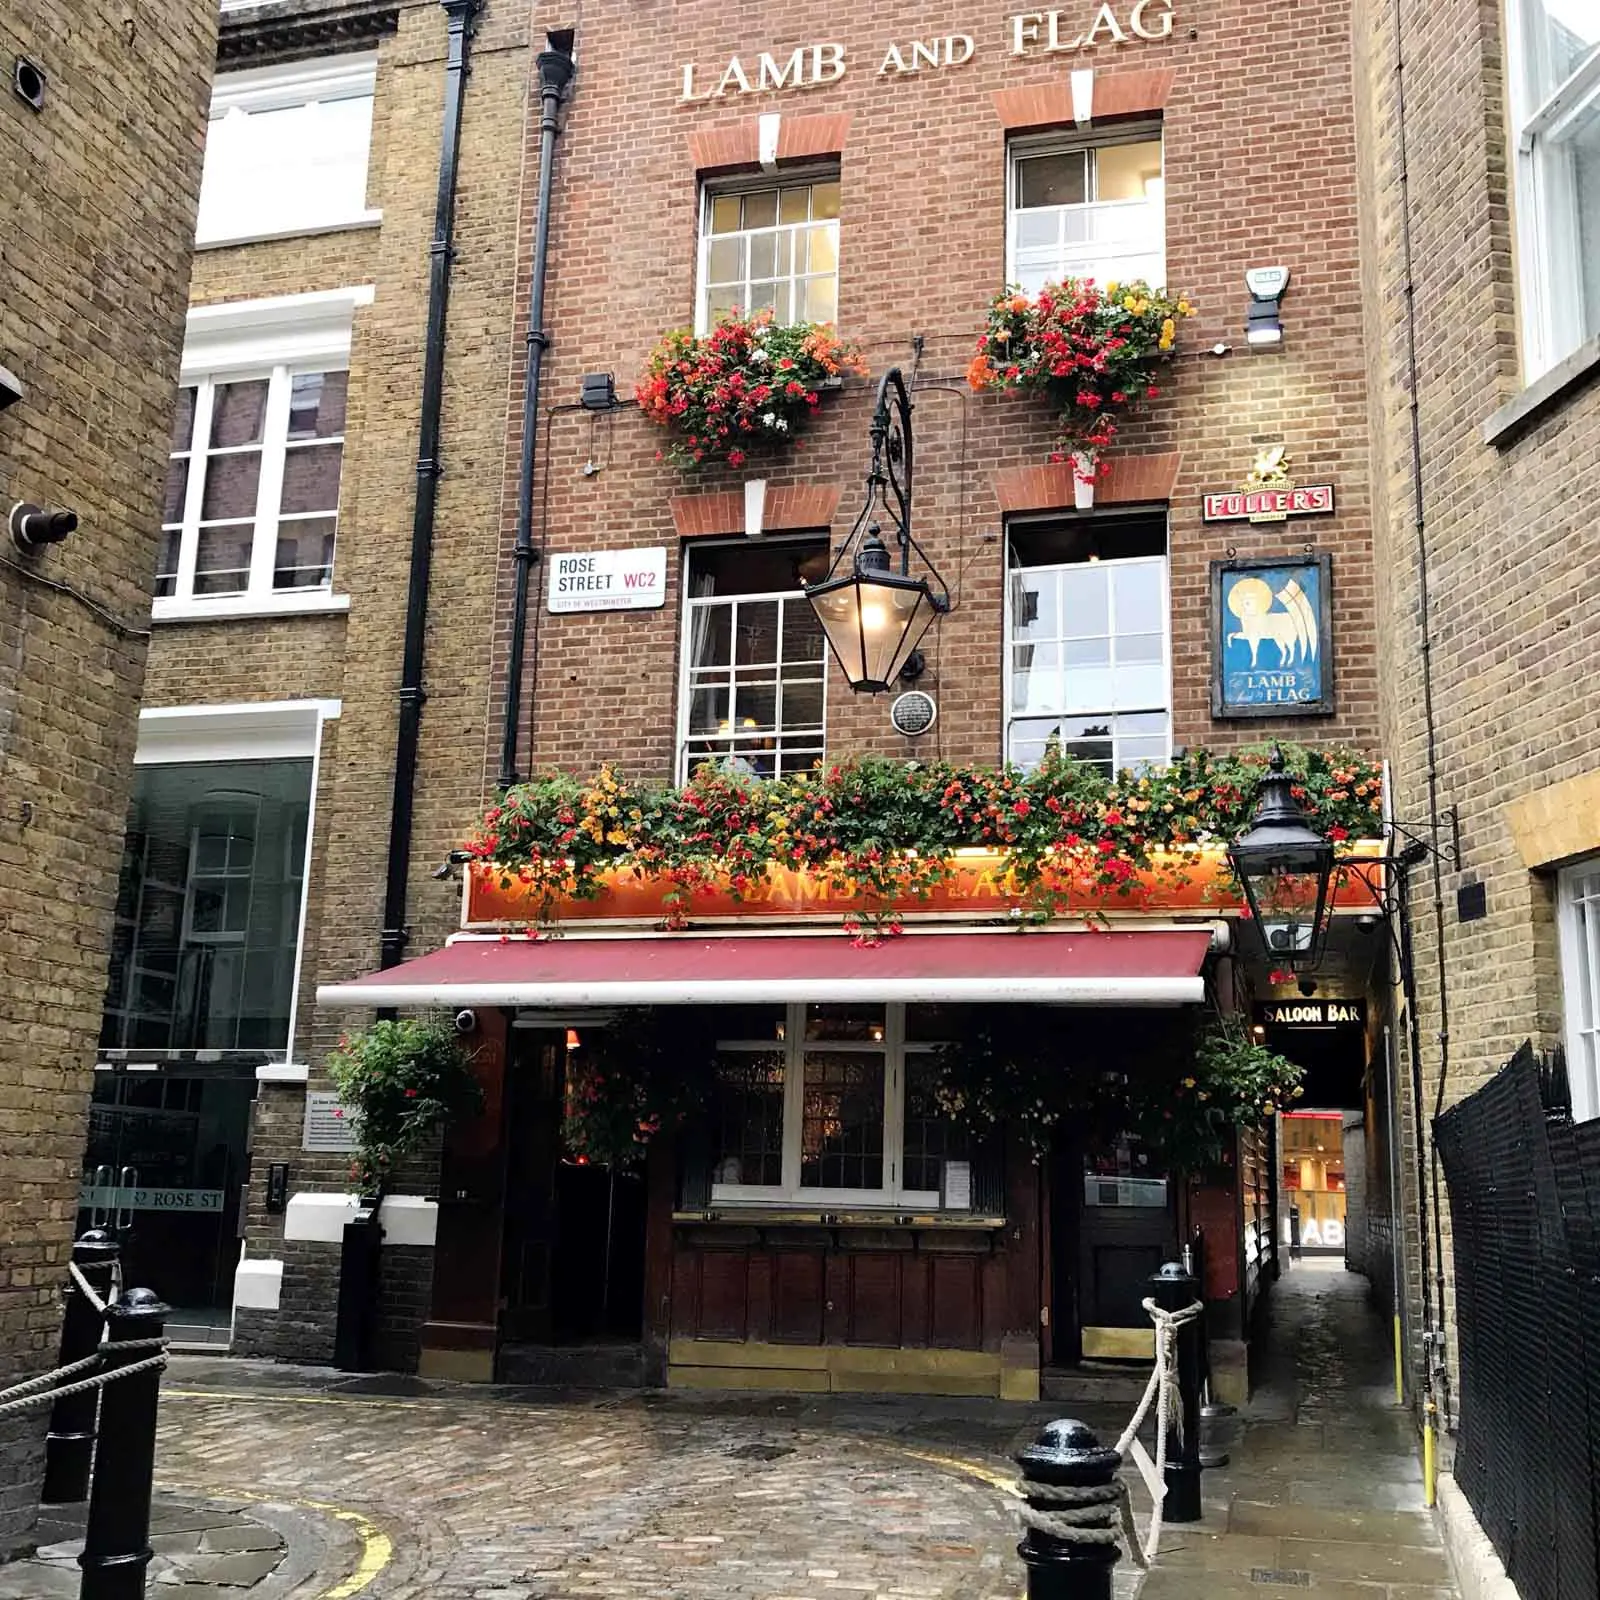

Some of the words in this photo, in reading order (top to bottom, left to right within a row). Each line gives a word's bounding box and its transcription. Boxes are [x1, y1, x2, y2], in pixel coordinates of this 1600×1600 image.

[678, 43, 846, 103] LAMB
[876, 34, 975, 75] AND
[1008, 0, 1177, 56] FLAG
[1209, 489, 1325, 516] FULLER'S
[559, 558, 596, 574] ROSE
[558, 574, 613, 592] STREET
[623, 572, 656, 589] WC2
[1247, 674, 1297, 689] LAMB
[1265, 687, 1311, 702] FLAG
[1264, 1006, 1322, 1023] SALOON
[1327, 1003, 1361, 1022] BAR
[153, 1192, 194, 1208] ROSE
[201, 1193, 222, 1208] ST
